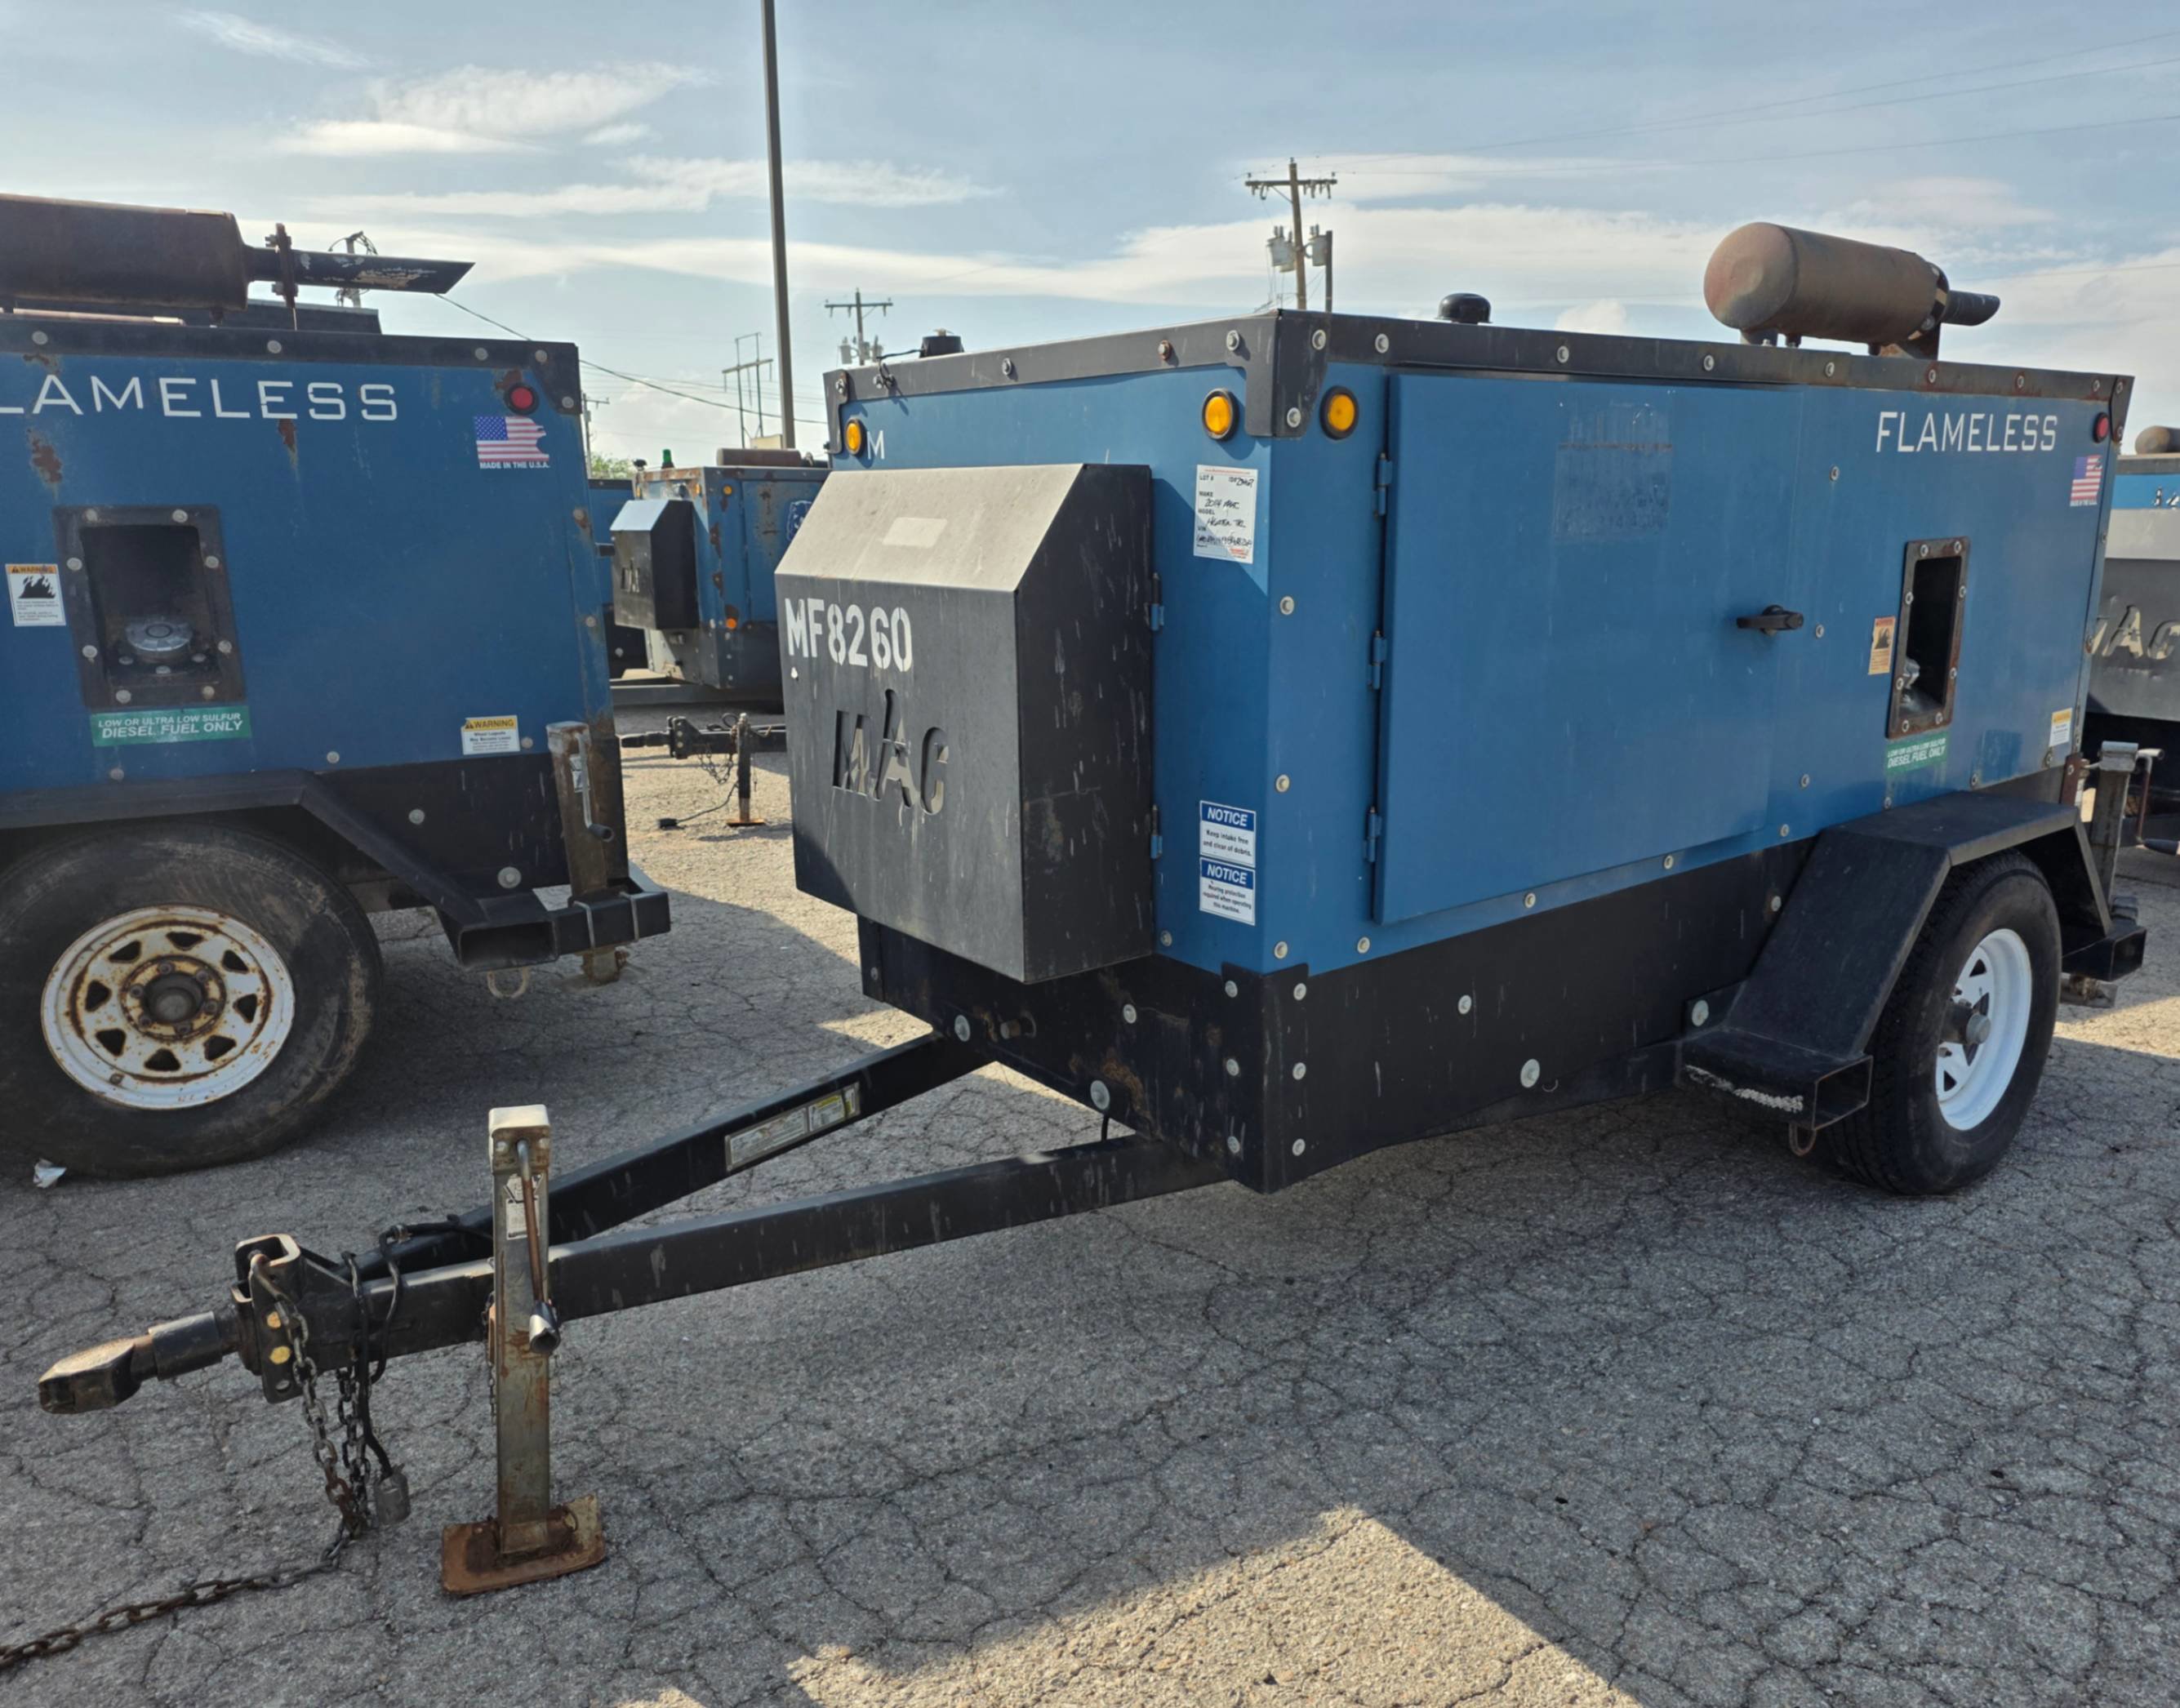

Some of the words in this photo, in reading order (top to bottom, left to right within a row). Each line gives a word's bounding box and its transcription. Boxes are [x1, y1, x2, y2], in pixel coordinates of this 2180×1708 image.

[1875, 411, 2058, 453] FLAMELESS
[866, 429, 886, 460] M
[479, 461, 501, 469] MADE
[785, 598, 914, 673] MF8260
[98, 719, 122, 728] LOW
[124, 718, 140, 727] OR
[142, 716, 175, 726] ULTRA
[176, 714, 200, 723] LOW
[202, 713, 241, 722] SULFUR
[102, 725, 157, 738] DIESEL
[160, 723, 199, 735] FUEL
[203, 721, 242, 732] ONLY
[474, 718, 514, 729] WARNING
[832, 688, 950, 816] MAC
[1911, 749, 1928, 763] FUEL
[1929, 744, 1946, 758] ONLY
[1207, 807, 1248, 827] NOTICE
[1207, 863, 1248, 885] NOTICE
